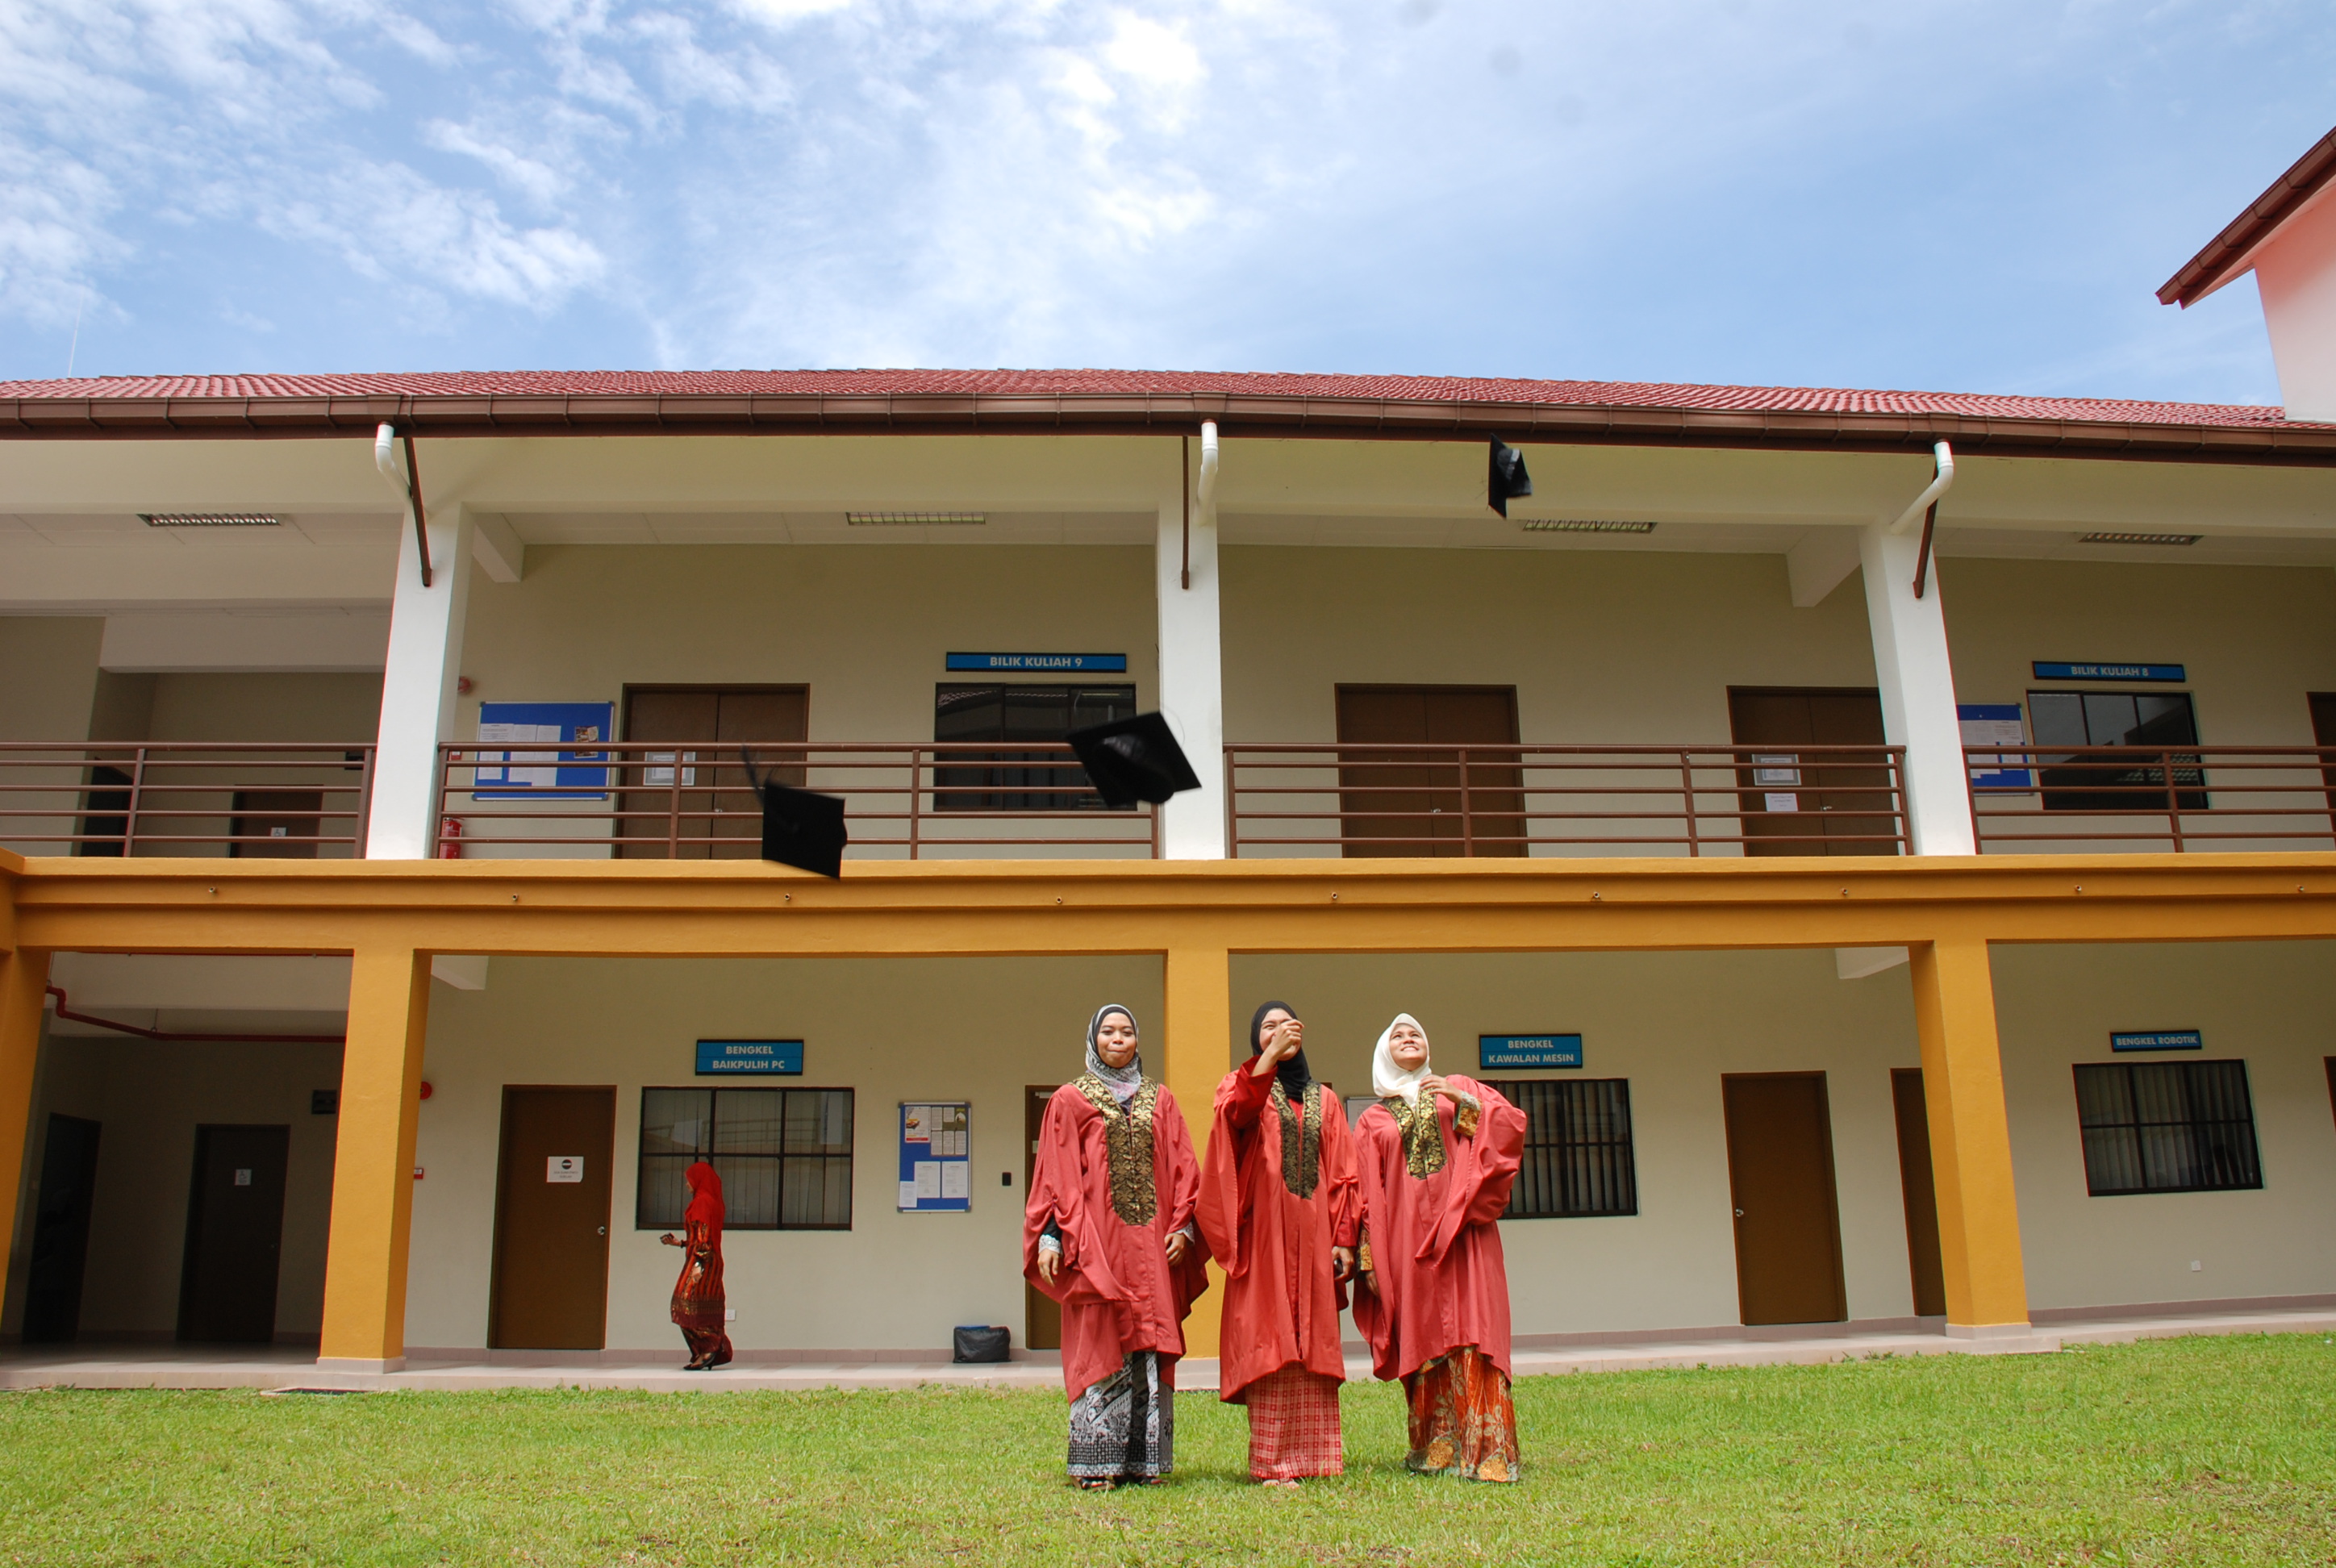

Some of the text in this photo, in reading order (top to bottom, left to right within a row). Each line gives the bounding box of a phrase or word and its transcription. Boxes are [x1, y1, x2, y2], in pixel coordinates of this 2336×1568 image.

[990, 657, 1082, 667] BILIK KULIAH 9
[2071, 666, 2149, 676] BILIK KULIAH 8
[1508, 1040, 1554, 1049] BENGKEL
[2116, 1036, 2197, 1046] BENGKEL ROBOTIK
[725, 1045, 774, 1054] BENGKEL
[1488, 1053, 1575, 1063] KAWALAN MESIN
[712, 1060, 785, 1069] BAIKPULIH PC
